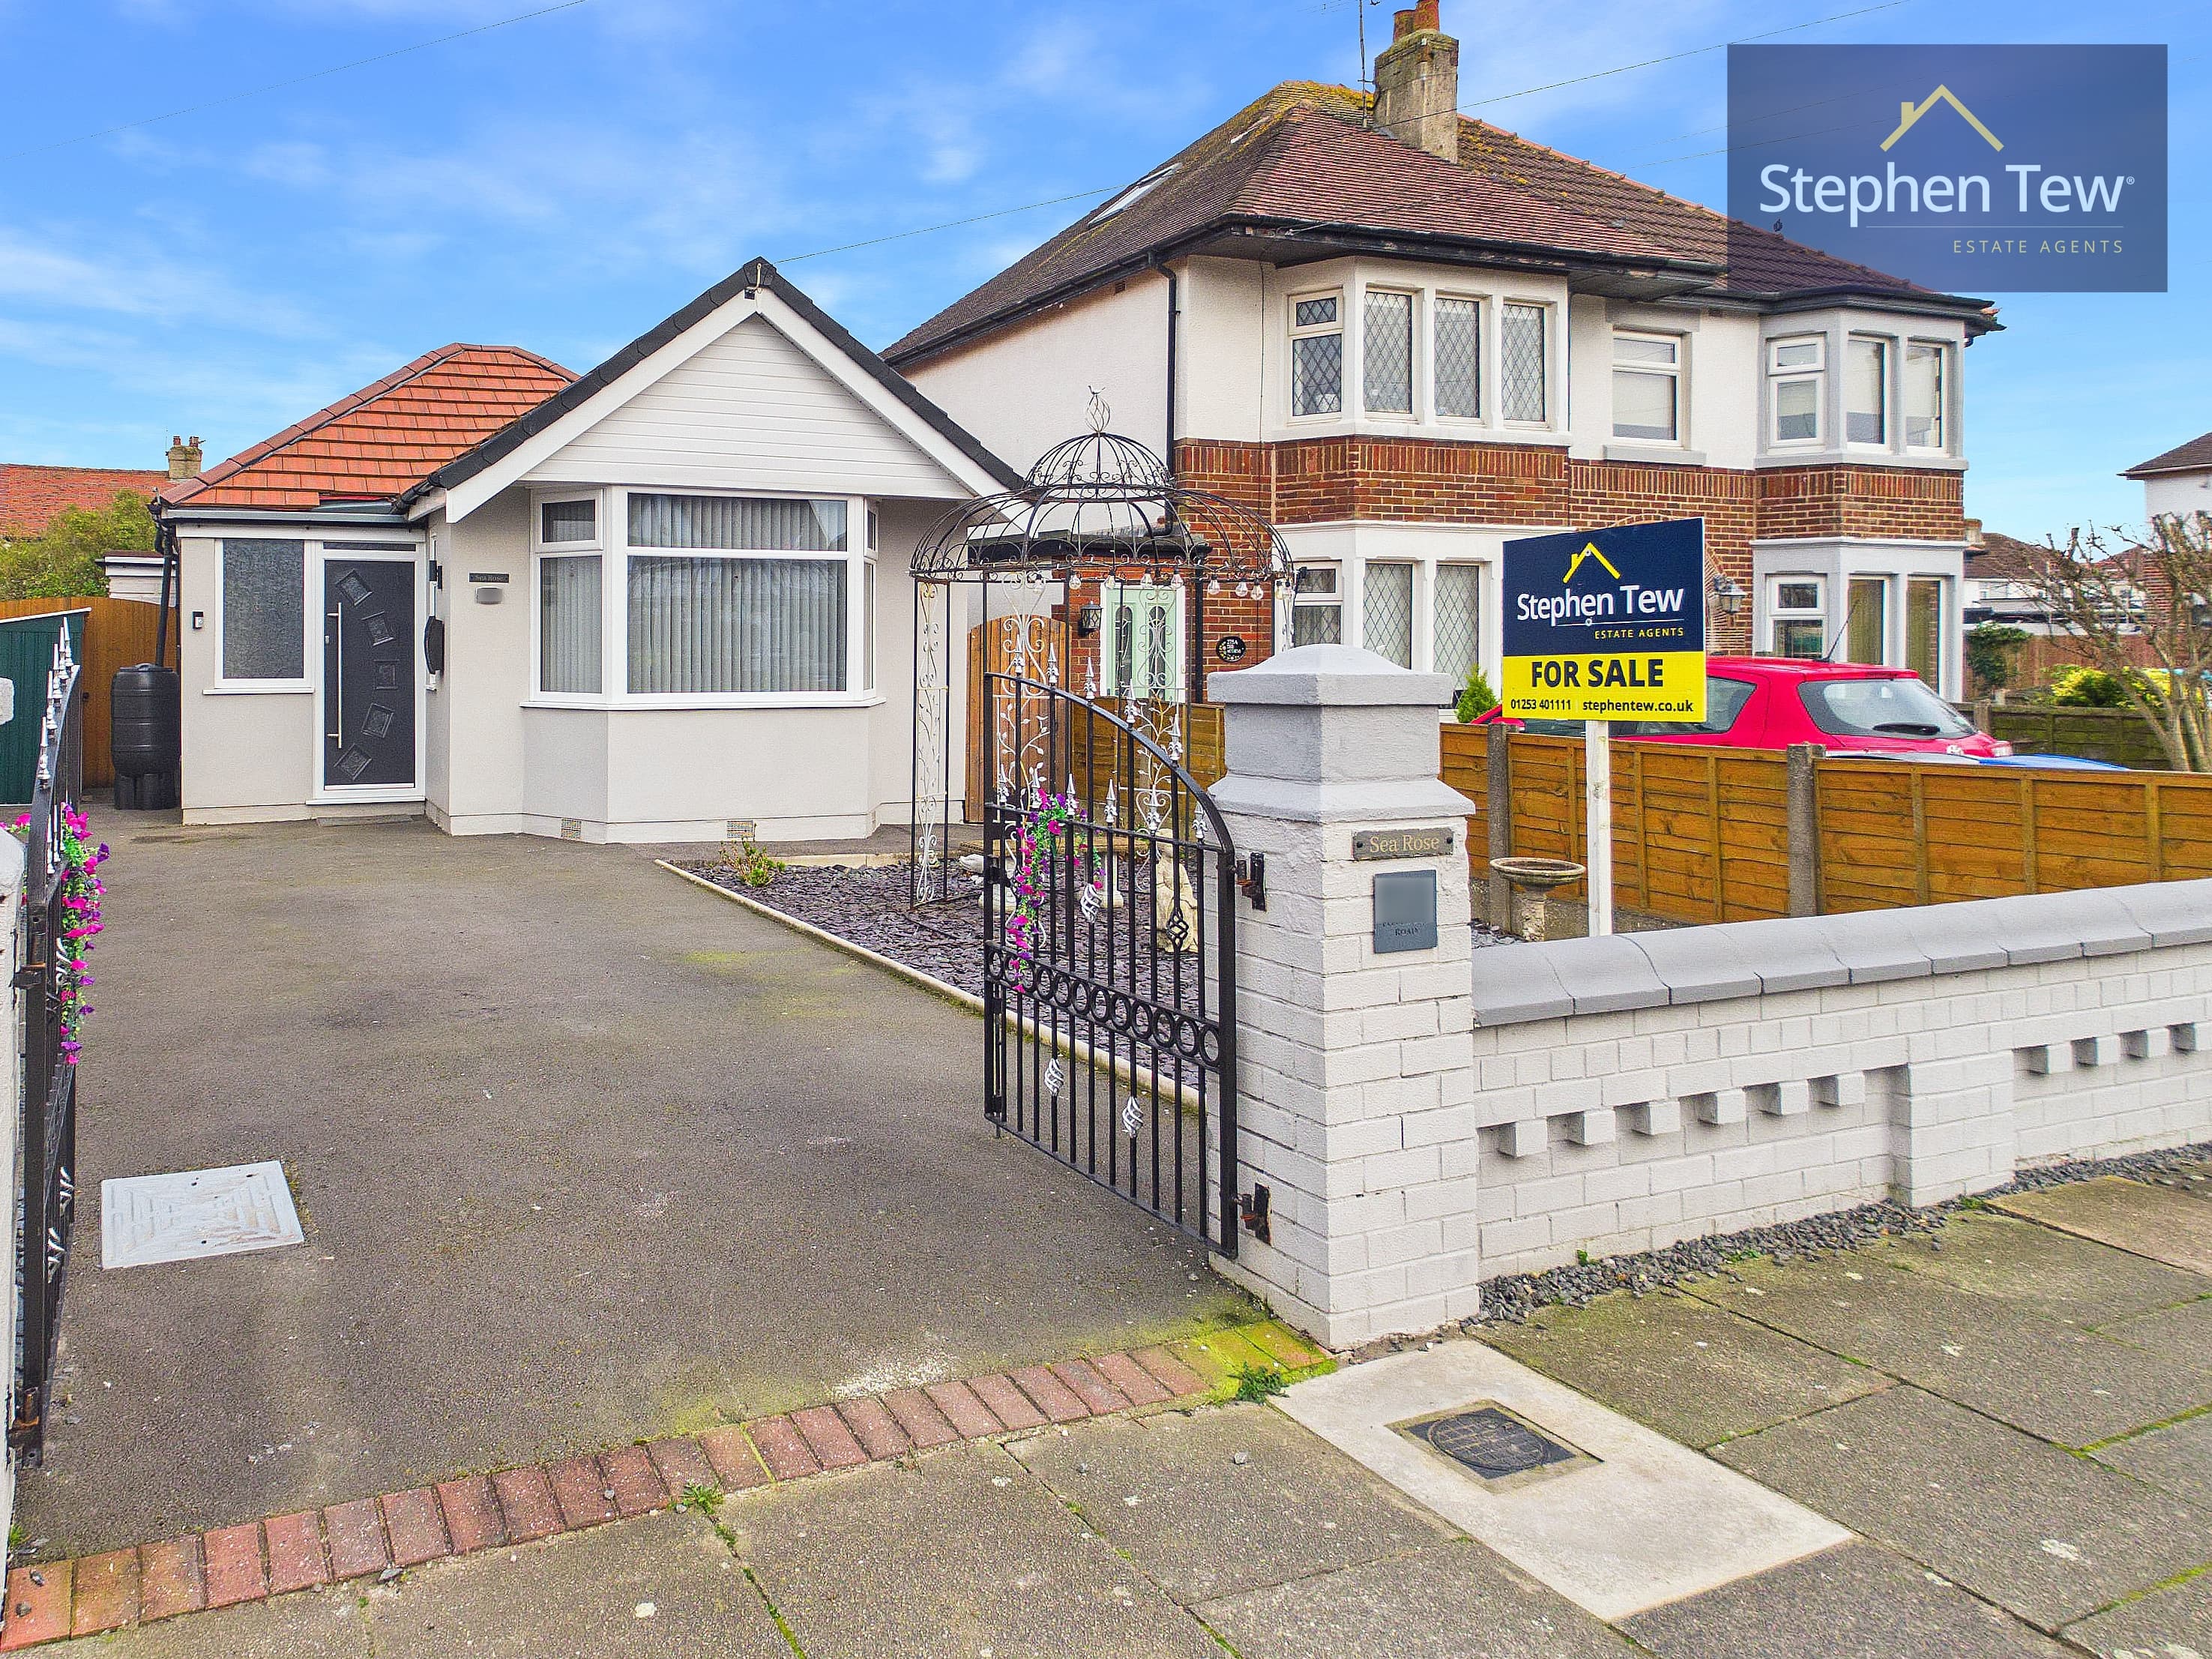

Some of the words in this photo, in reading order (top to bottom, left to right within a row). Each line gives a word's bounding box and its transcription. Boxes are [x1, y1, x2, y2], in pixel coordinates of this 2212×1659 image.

[1516, 588, 1614, 627] Stephen
[1619, 585, 1684, 615] Tew
[1594, 629, 1634, 639] ESTATE
[1639, 627, 1684, 638] AGENTS
[1531, 661, 1580, 687] FOR
[1588, 659, 1664, 687] SALE
[1510, 699, 1537, 710] 01253
[1539, 699, 1572, 710] 401111
[1582, 699, 1694, 714] stephentew.co.uk
[1369, 836, 1399, 853] Sea
[1402, 834, 1440, 852] Rose
